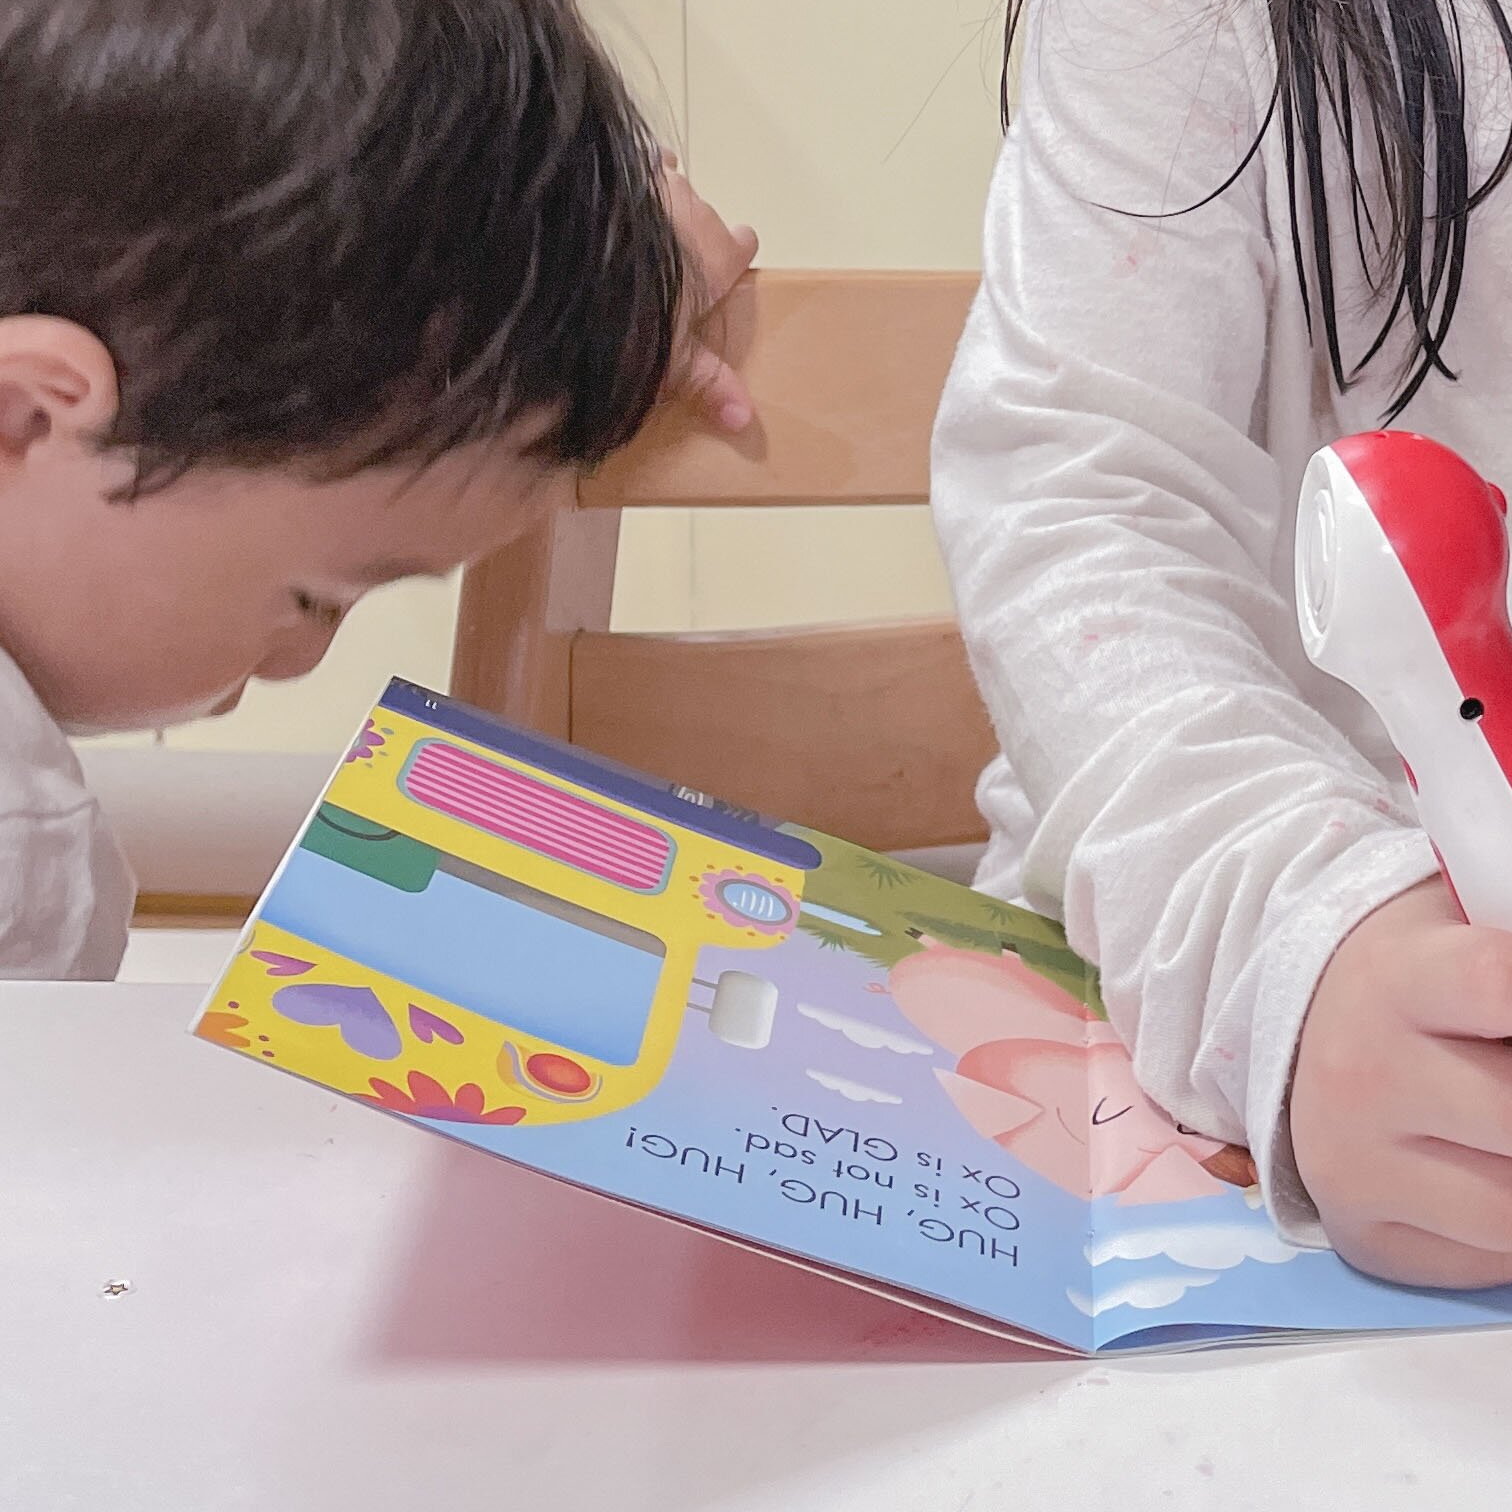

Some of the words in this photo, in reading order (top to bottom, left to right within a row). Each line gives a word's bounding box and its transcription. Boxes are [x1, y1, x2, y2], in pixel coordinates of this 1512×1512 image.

[734, 1127, 817, 1166] sad.
[771, 1105, 899, 1162] GLAD.
[625, 1126, 745, 1184] HUG!
[916, 1151, 943, 1178] is
[832, 1160, 895, 1190] not
[961, 1164, 1022, 1200] Ox
[770, 1168, 883, 1226] HUG,
[913, 1183, 941, 1208] is
[960, 1194, 1021, 1231] Ox
[905, 1207, 1020, 1267] HUG,
